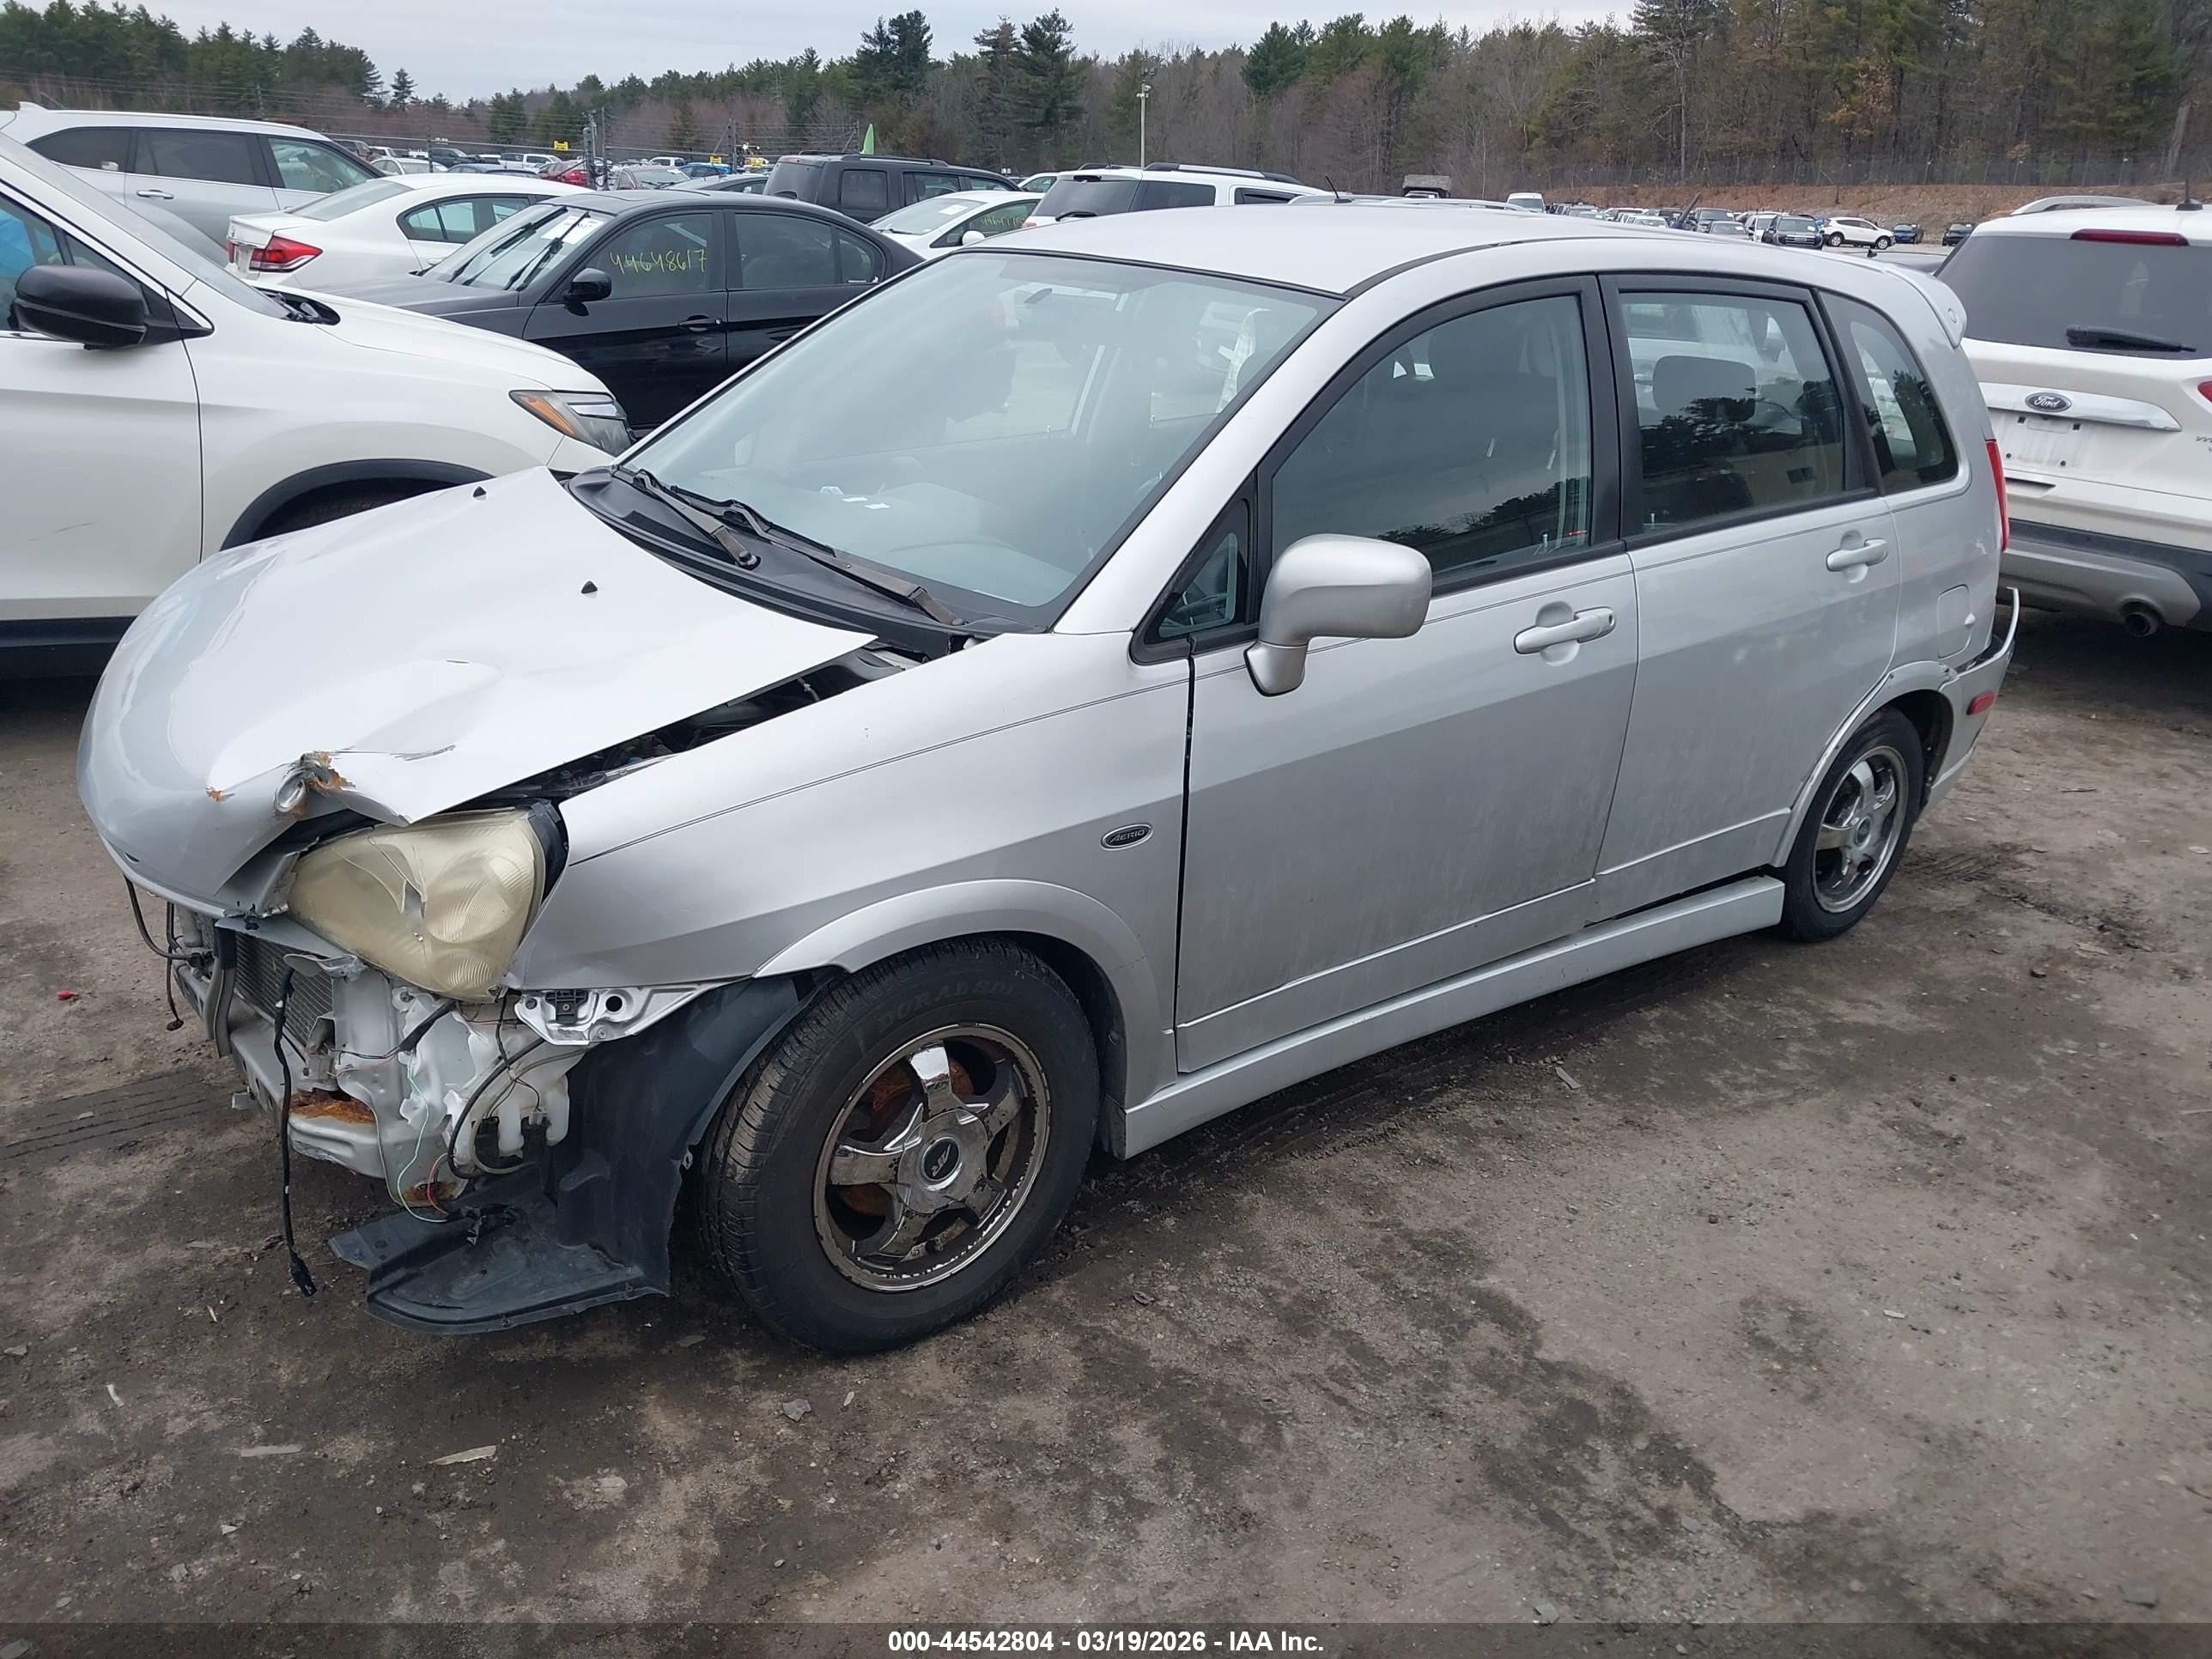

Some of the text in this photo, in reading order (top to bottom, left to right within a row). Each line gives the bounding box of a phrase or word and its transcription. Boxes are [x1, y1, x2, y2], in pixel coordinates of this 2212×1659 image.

[610, 249, 708, 276] 44648617
[2034, 395, 2061, 407] Ford
[1110, 830, 1145, 842] AERIO
